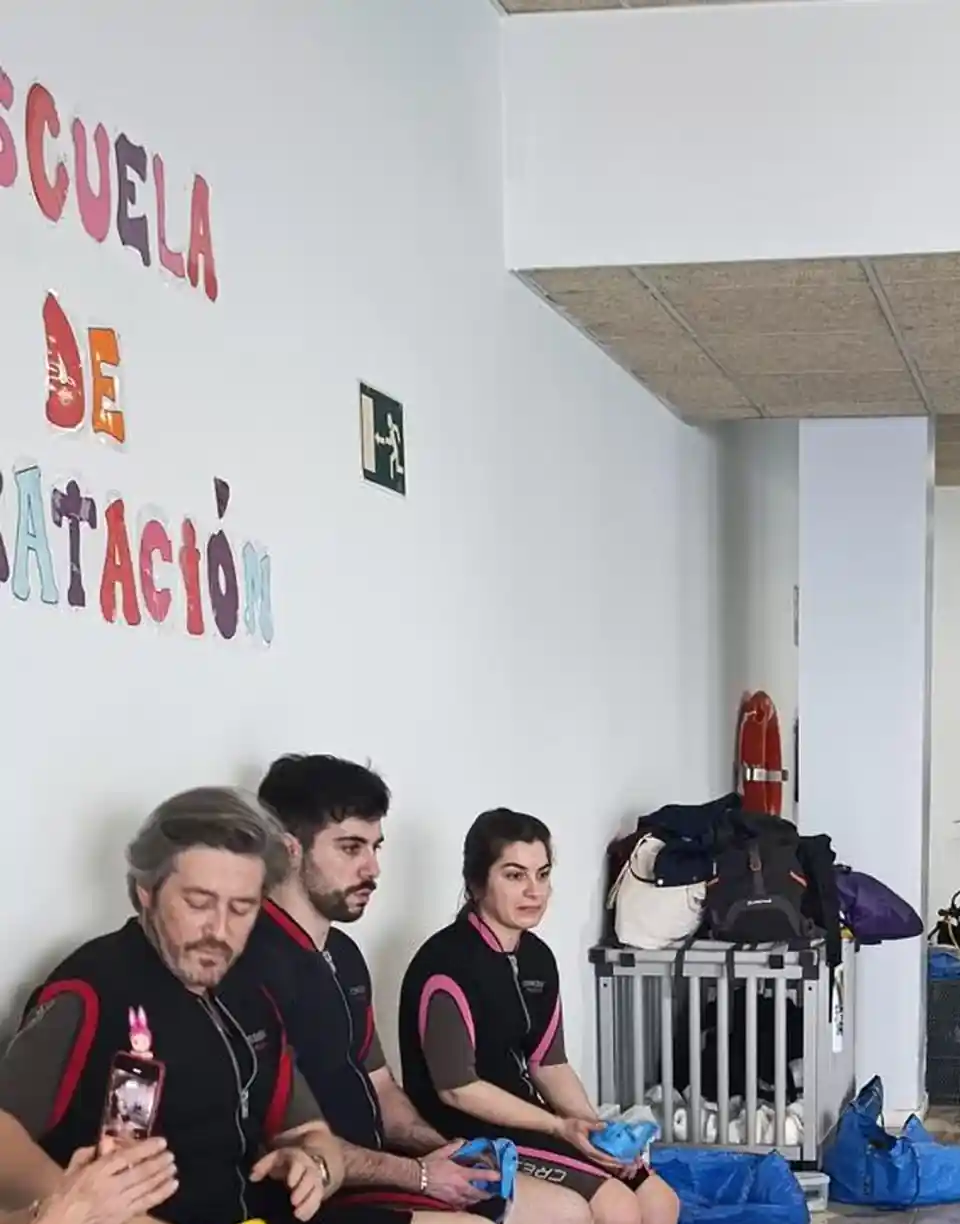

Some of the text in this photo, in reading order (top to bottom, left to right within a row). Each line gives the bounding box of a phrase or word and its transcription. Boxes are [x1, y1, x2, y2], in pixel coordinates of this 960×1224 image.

[42, 292, 125, 443] DE
[0, 465, 273, 643] ATACIÓN
[516, 1161, 567, 1182] CRE
